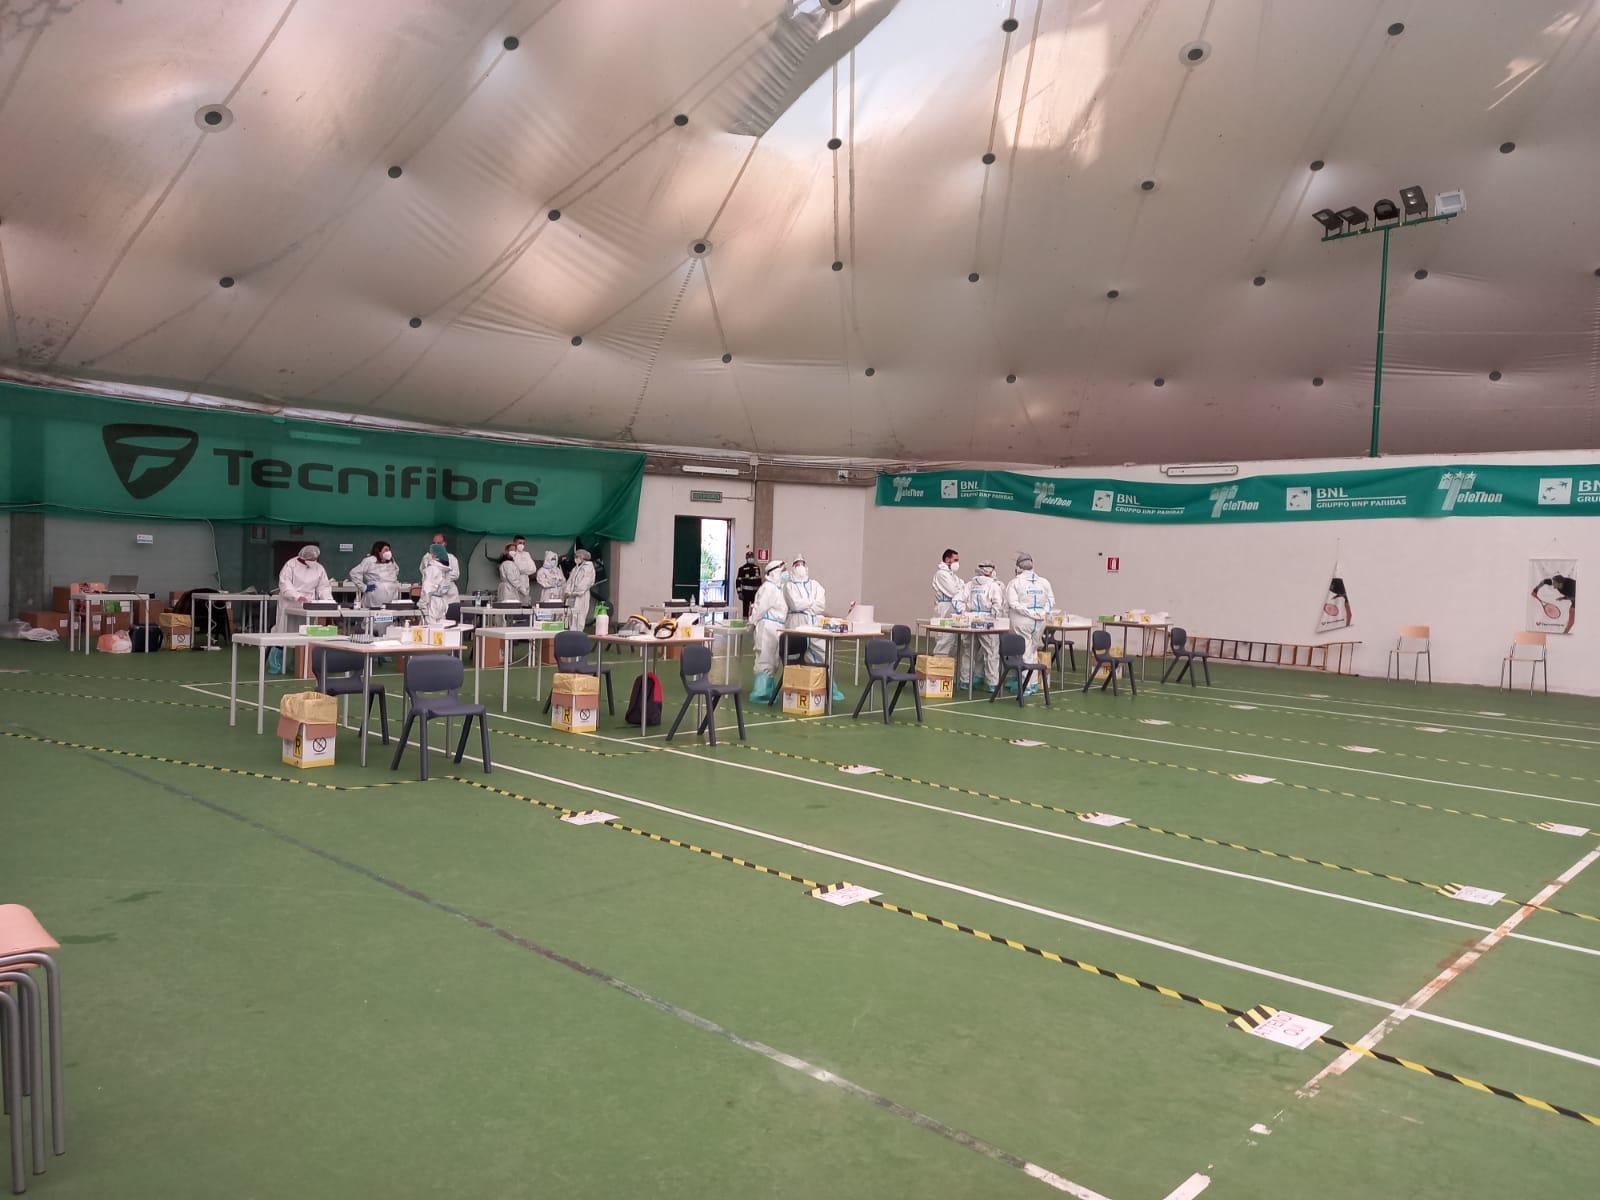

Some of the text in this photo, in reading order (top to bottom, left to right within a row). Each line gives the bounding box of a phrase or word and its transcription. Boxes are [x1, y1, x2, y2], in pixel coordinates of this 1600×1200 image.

[213, 447, 539, 506] Tecnifibre
[960, 480, 979, 490] BNL
[1437, 471, 1504, 511] TeleThon
[1578, 479, 1600, 492] BN
[1116, 493, 1140, 505] BNL
[1316, 487, 1348, 499] BNL
[1576, 495, 1600, 503] GRU
[1209, 485, 1260, 518] TeleThon
[1316, 501, 1350, 509] GRUPPO
[1370, 498, 1407, 506] PARIBAS
[1115, 506, 1141, 514] GRUPPO
[800, 695, 807, 706] R
[295, 737, 302, 756] R
